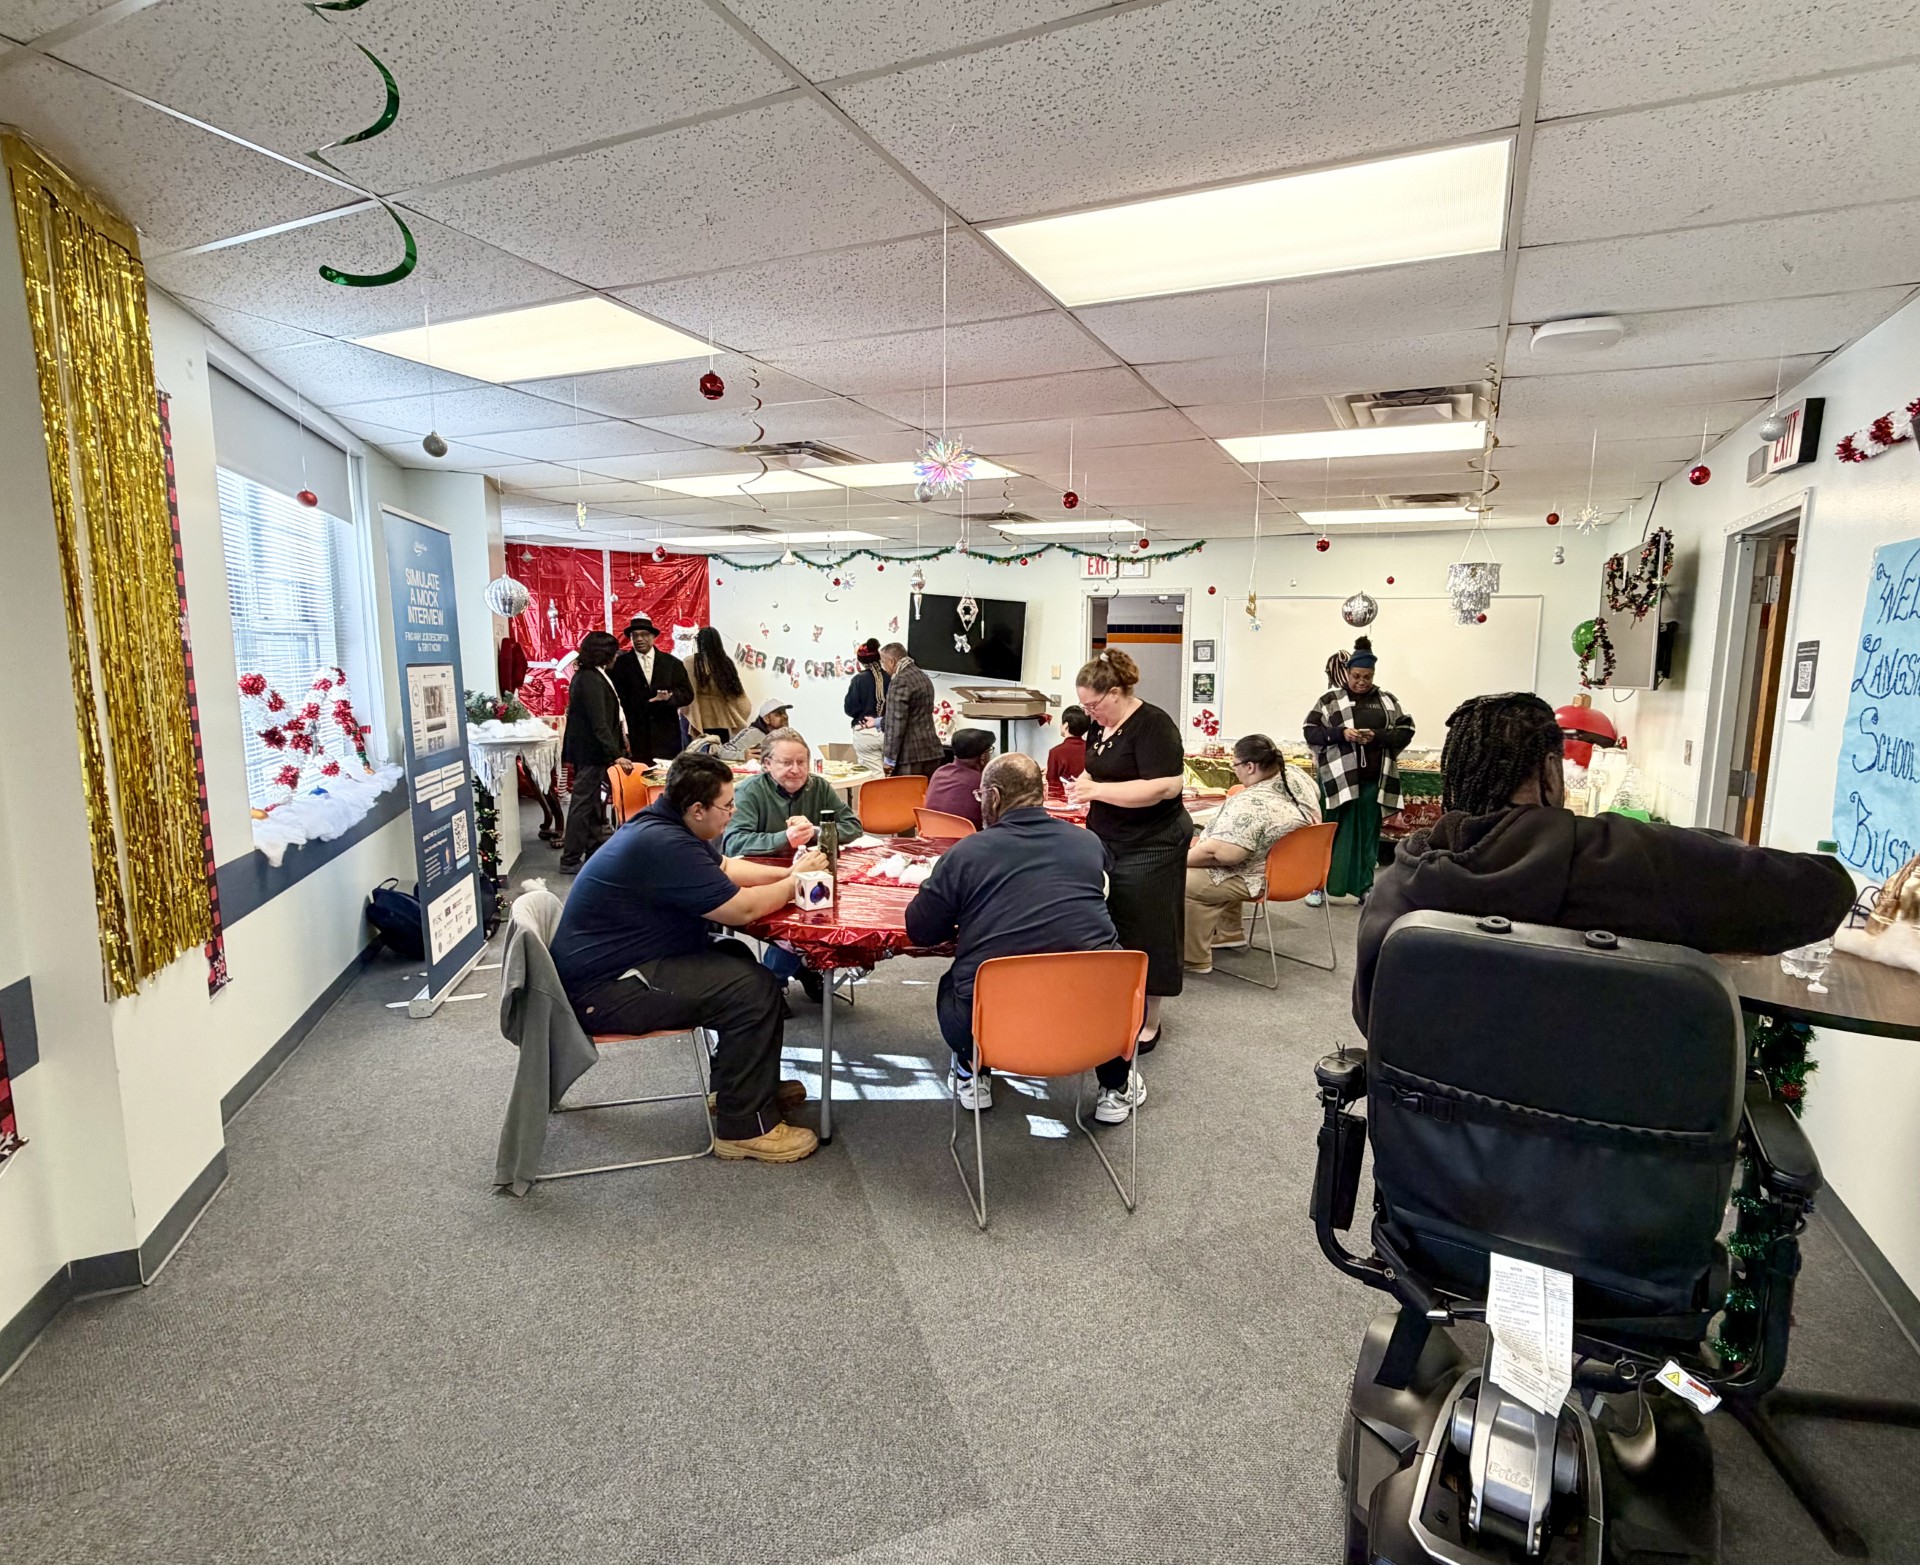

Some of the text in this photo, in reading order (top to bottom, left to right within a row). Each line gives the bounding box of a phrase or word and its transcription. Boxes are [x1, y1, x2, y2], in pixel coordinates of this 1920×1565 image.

[1087, 556, 1110, 576] EXIT
[405, 568, 440, 590] SIMULATE
[410, 587, 439, 607] A MOCK
[408, 606, 443, 626] INTERVIEW
[804, 656, 861, 678] CHRIS
[1488, 1461, 1530, 1488] Pride
